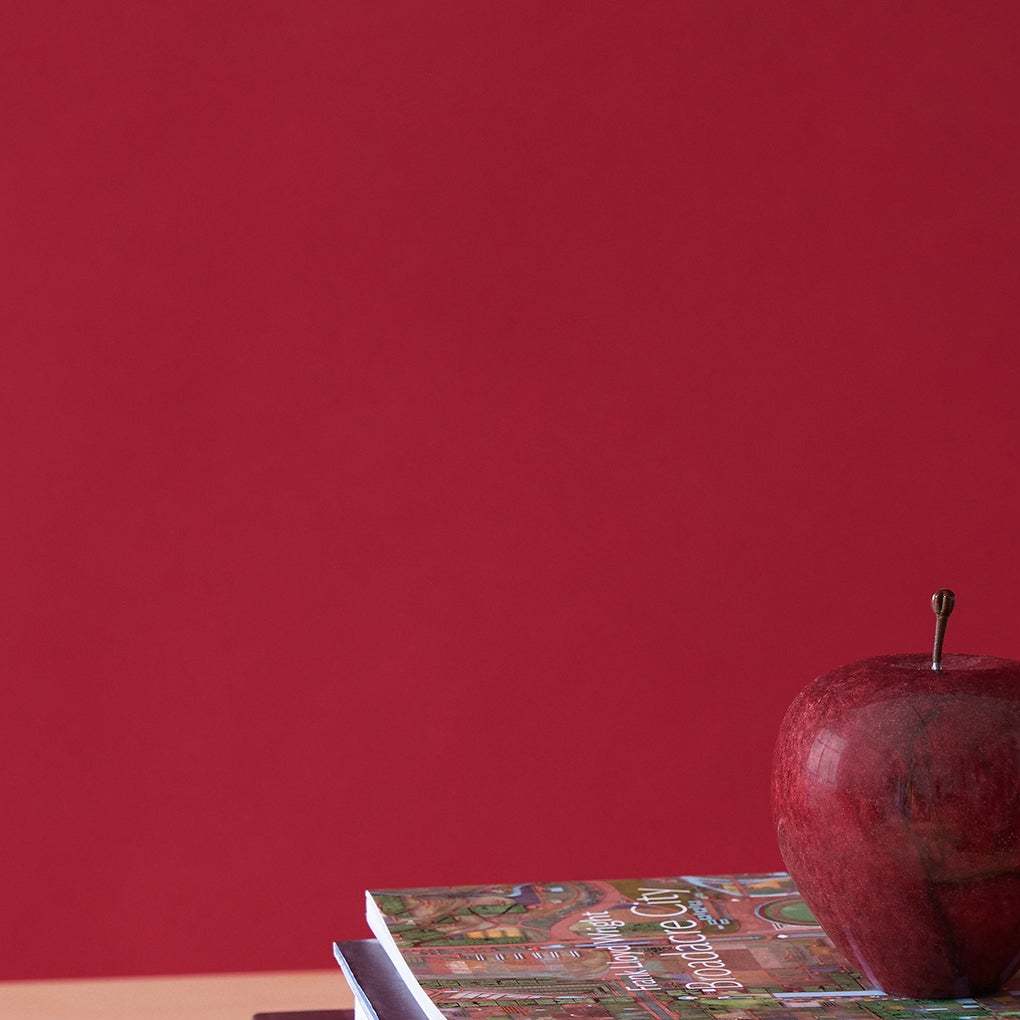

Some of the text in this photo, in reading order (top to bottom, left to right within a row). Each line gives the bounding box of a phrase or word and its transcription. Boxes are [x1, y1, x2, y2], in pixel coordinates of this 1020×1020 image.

[579, 910, 662, 991] Frank Lloyd Wright
[629, 887, 744, 991] Broadacre City
